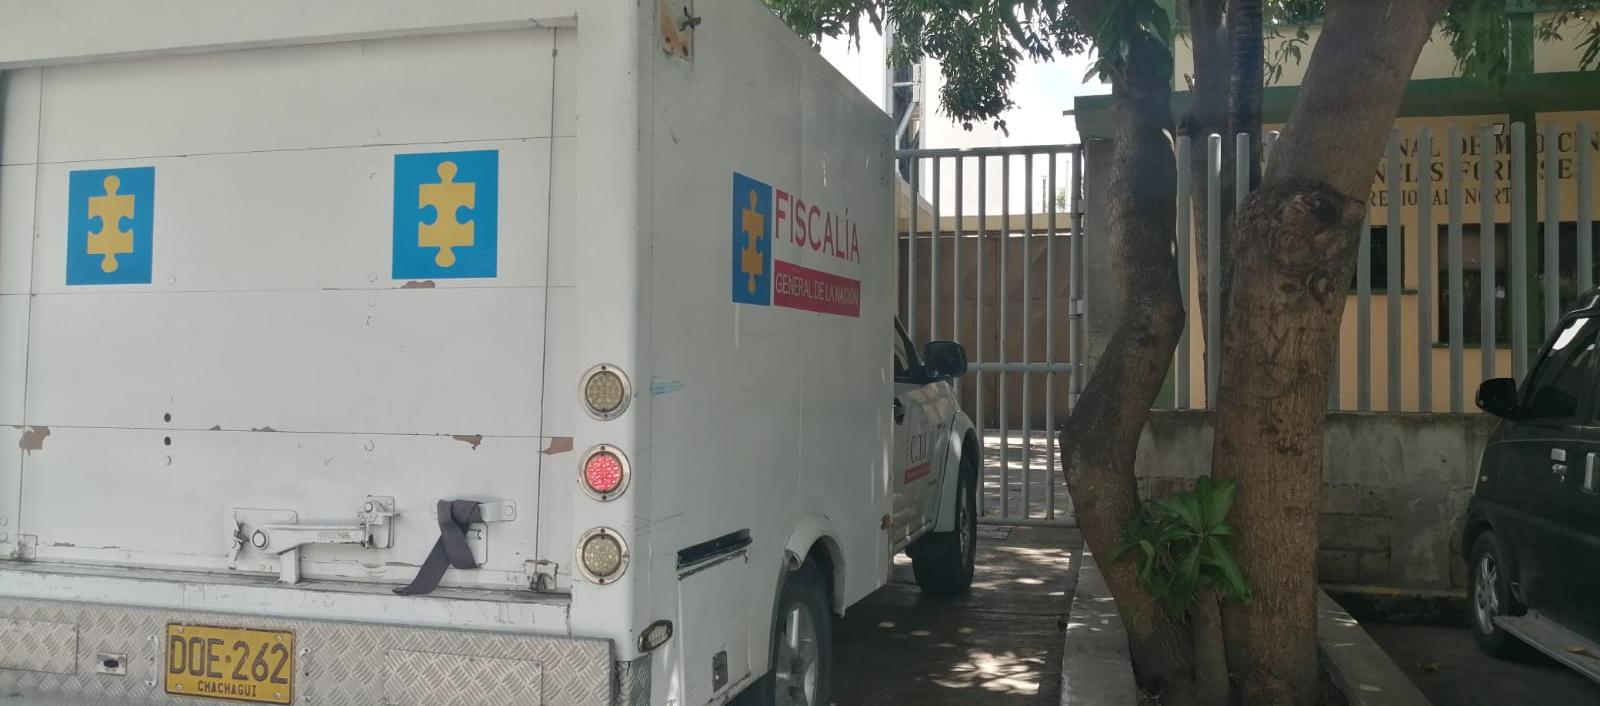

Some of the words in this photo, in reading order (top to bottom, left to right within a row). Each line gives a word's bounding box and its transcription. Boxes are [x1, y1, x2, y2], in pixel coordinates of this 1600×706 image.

[775, 188, 860, 264] FISCALÍA
[775, 271, 813, 299] GENERAL
[814, 280, 825, 301] DE
[825, 282, 835, 304] LA
[197, 680, 257, 698] CHACHAGUI
